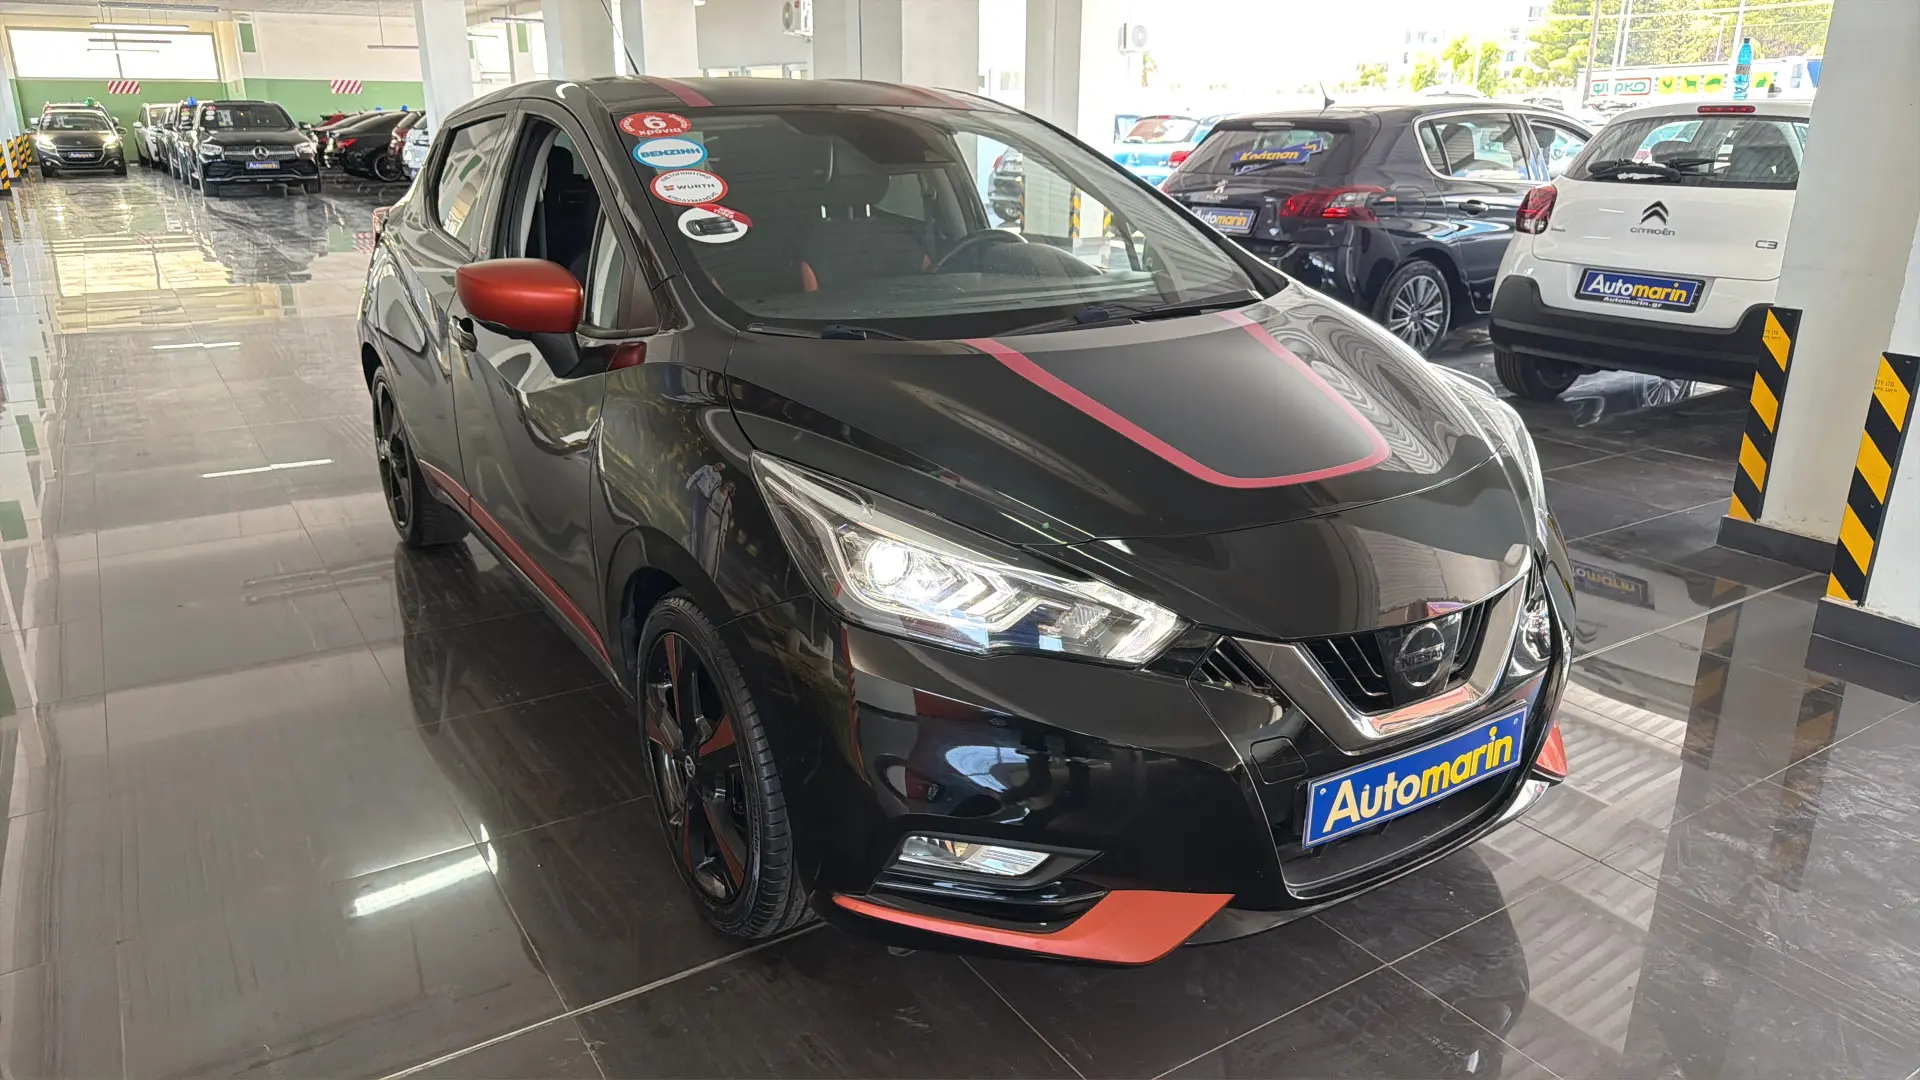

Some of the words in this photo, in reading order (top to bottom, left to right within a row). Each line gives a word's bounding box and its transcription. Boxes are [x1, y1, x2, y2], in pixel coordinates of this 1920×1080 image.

[644, 117, 667, 129] 6
[639, 128, 682, 136] χρόνια
[1195, 210, 1247, 226] Automarin
[1755, 240, 1778, 249] C3
[1588, 274, 1687, 302] Automarin
[1603, 296, 1662, 308] Automarin.gr
[1402, 644, 1444, 668] NISSAN
[1322, 726, 1513, 833] Automarin
